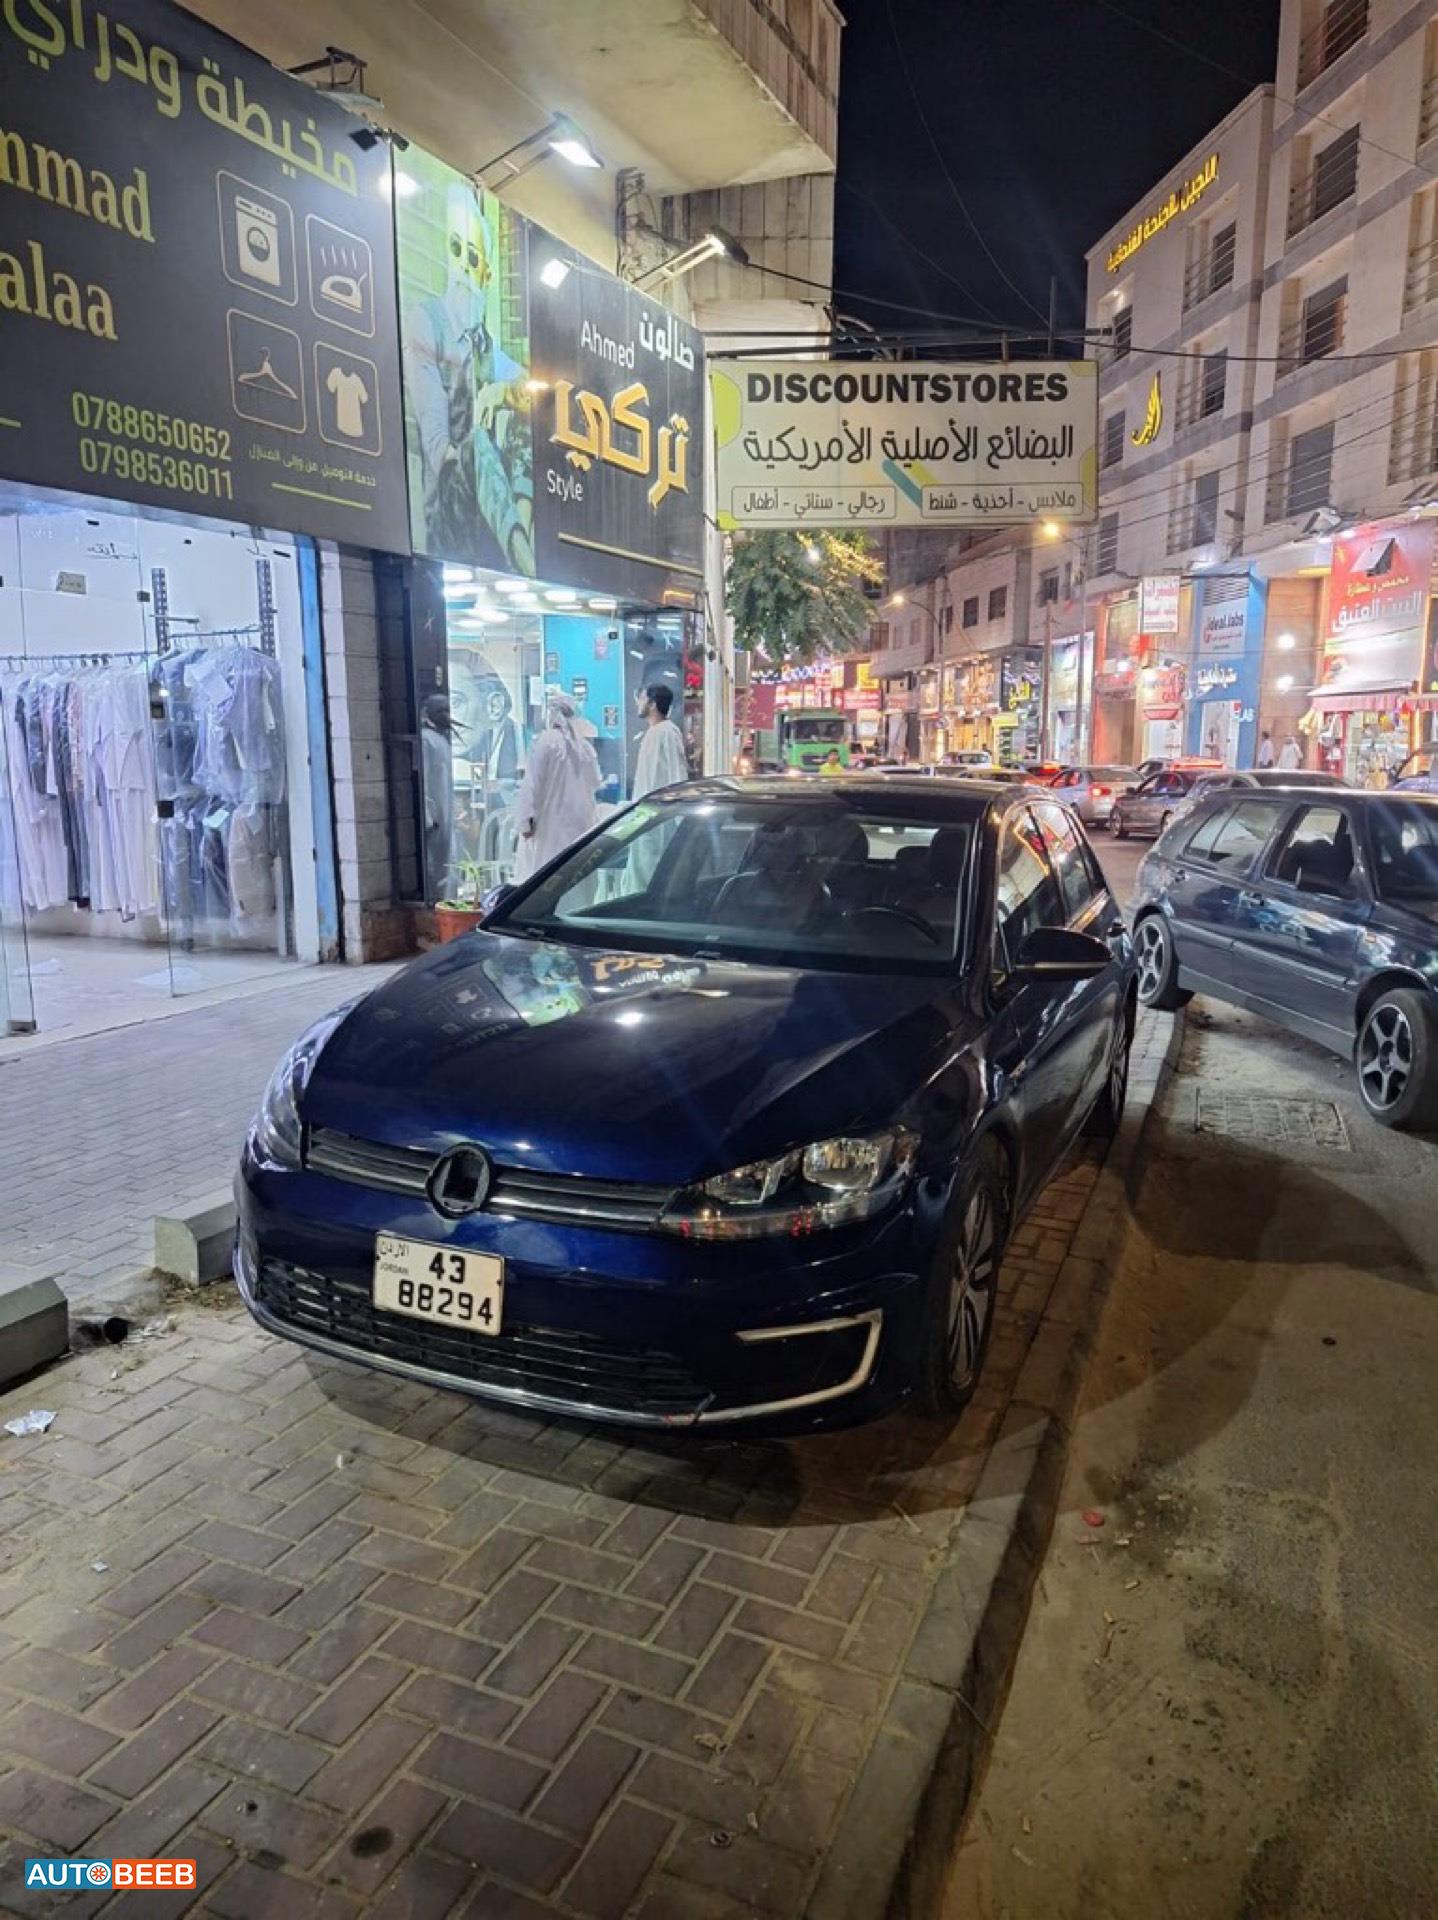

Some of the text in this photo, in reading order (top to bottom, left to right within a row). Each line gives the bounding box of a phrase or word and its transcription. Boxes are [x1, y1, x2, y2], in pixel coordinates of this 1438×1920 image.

[580, 319, 635, 370] Ahmed
[638, 310, 695, 371] صالون
[747, 372, 1069, 403] DISCOUNTSTORES
[72, 391, 232, 462] 0788650652
[742, 419, 1074, 470] البضائع الأصلية الأمريكية
[79, 438, 233, 500] 0798536011
[546, 468, 584, 502] Style
[1028, 490, 1076, 512] ملابس
[428, 1251, 466, 1284] 43
[398, 1278, 494, 1326] 88294
